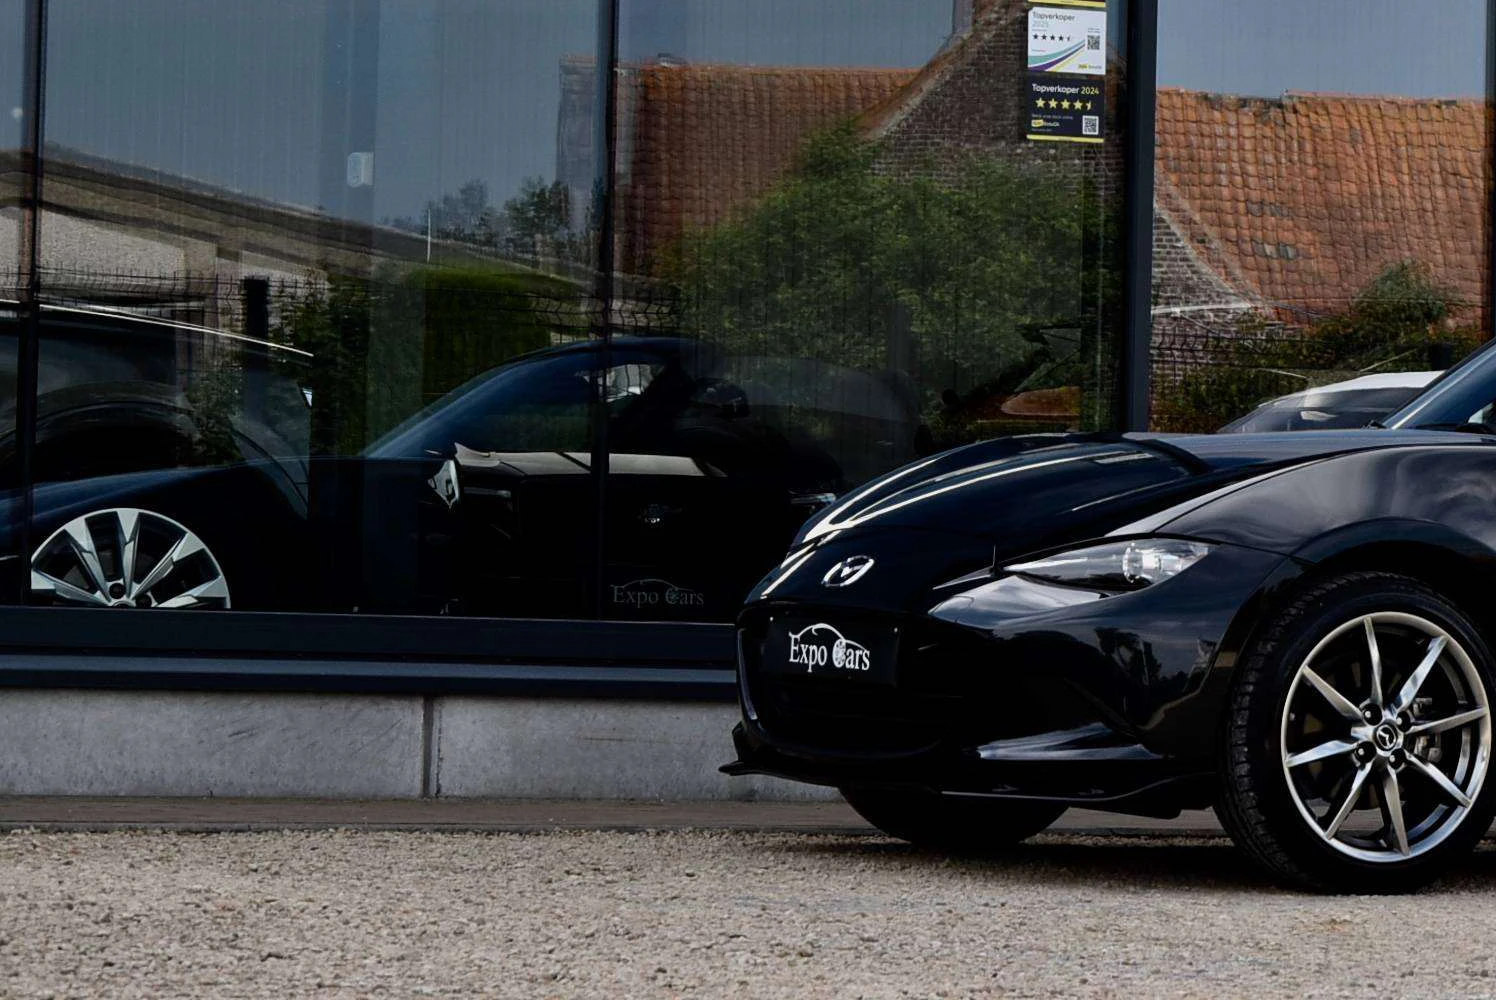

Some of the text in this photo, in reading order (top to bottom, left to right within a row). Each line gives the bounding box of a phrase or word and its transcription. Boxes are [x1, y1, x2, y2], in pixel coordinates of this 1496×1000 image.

[1031, 83, 1099, 95] Topverkoper 2024
[613, 585, 705, 608] Expo Cars
[788, 632, 870, 673] Expo Cars
